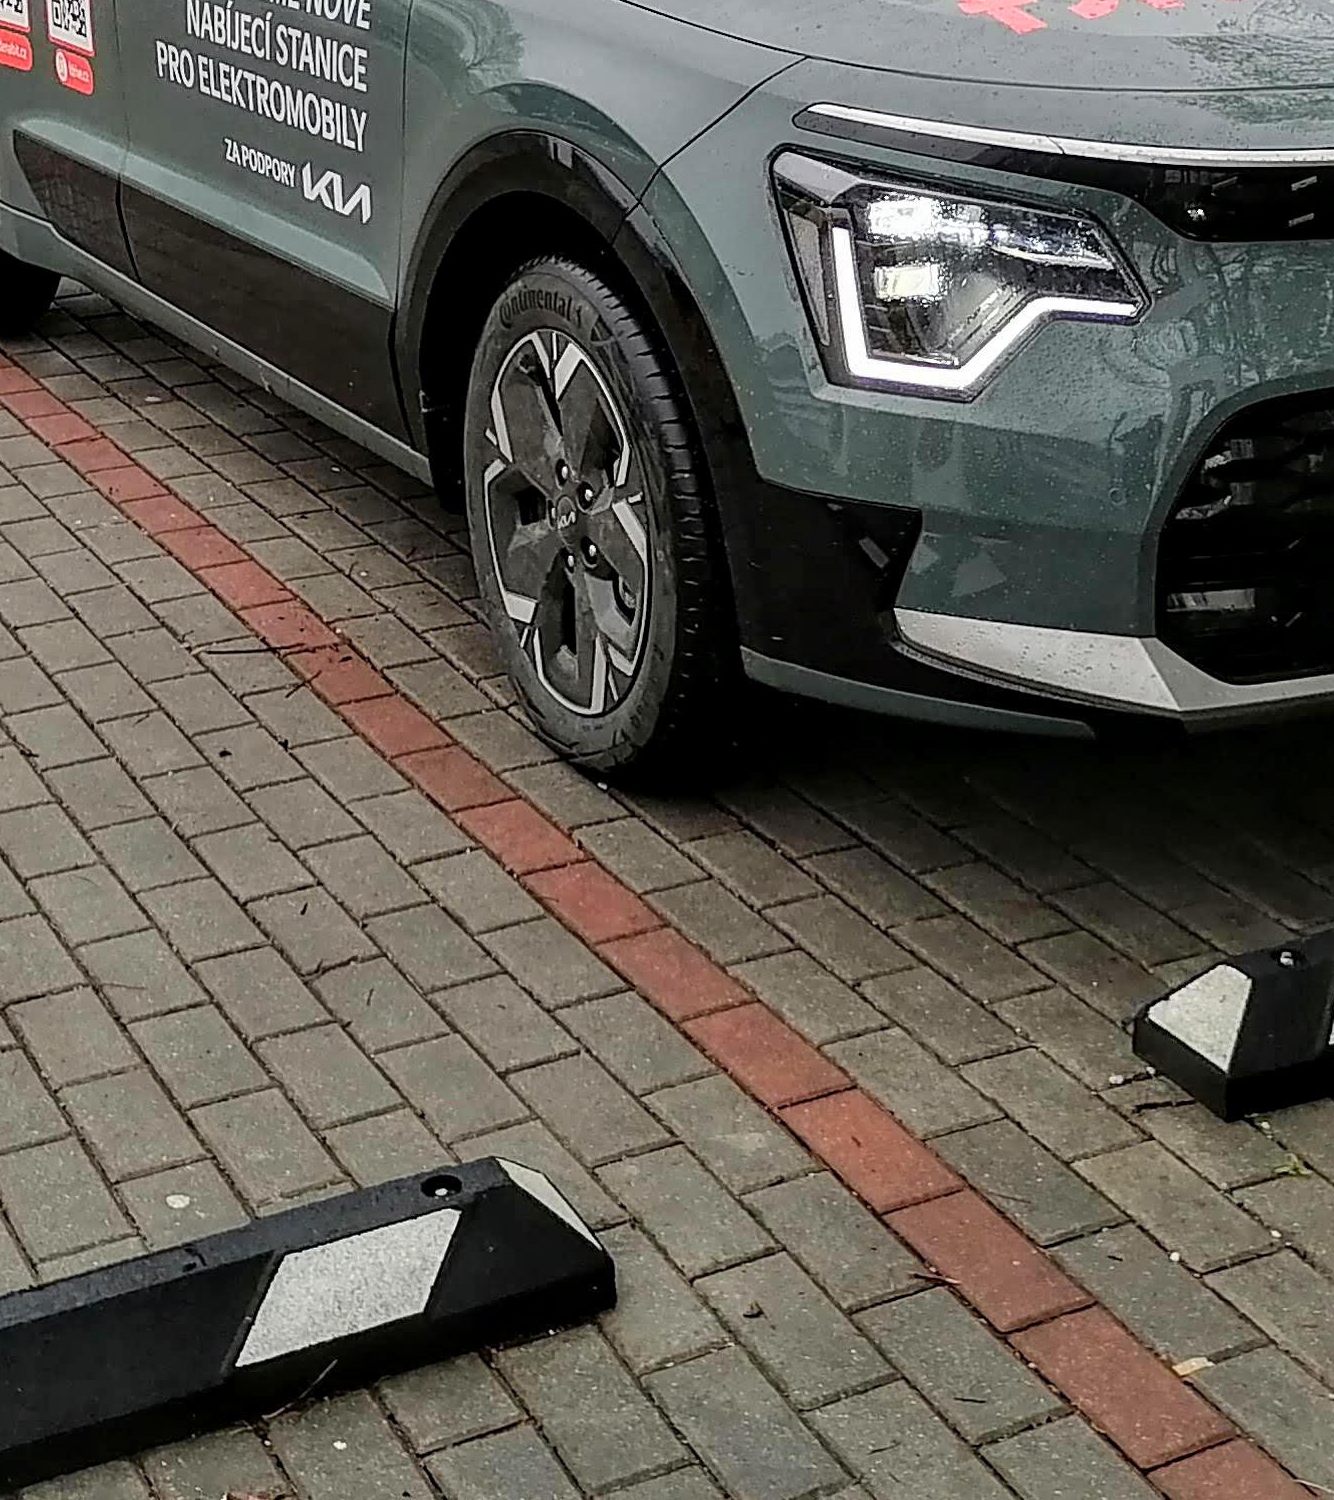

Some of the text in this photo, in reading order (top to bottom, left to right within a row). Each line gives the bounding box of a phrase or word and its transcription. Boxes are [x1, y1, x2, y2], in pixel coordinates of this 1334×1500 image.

[275, 24, 368, 92] STANICE
[156, 40, 367, 152] PRO ELEKTROMOBILY
[224, 138, 296, 188] ZA PODPORY
[301, 161, 372, 224] KIA
[499, 289, 572, 329] Continental
